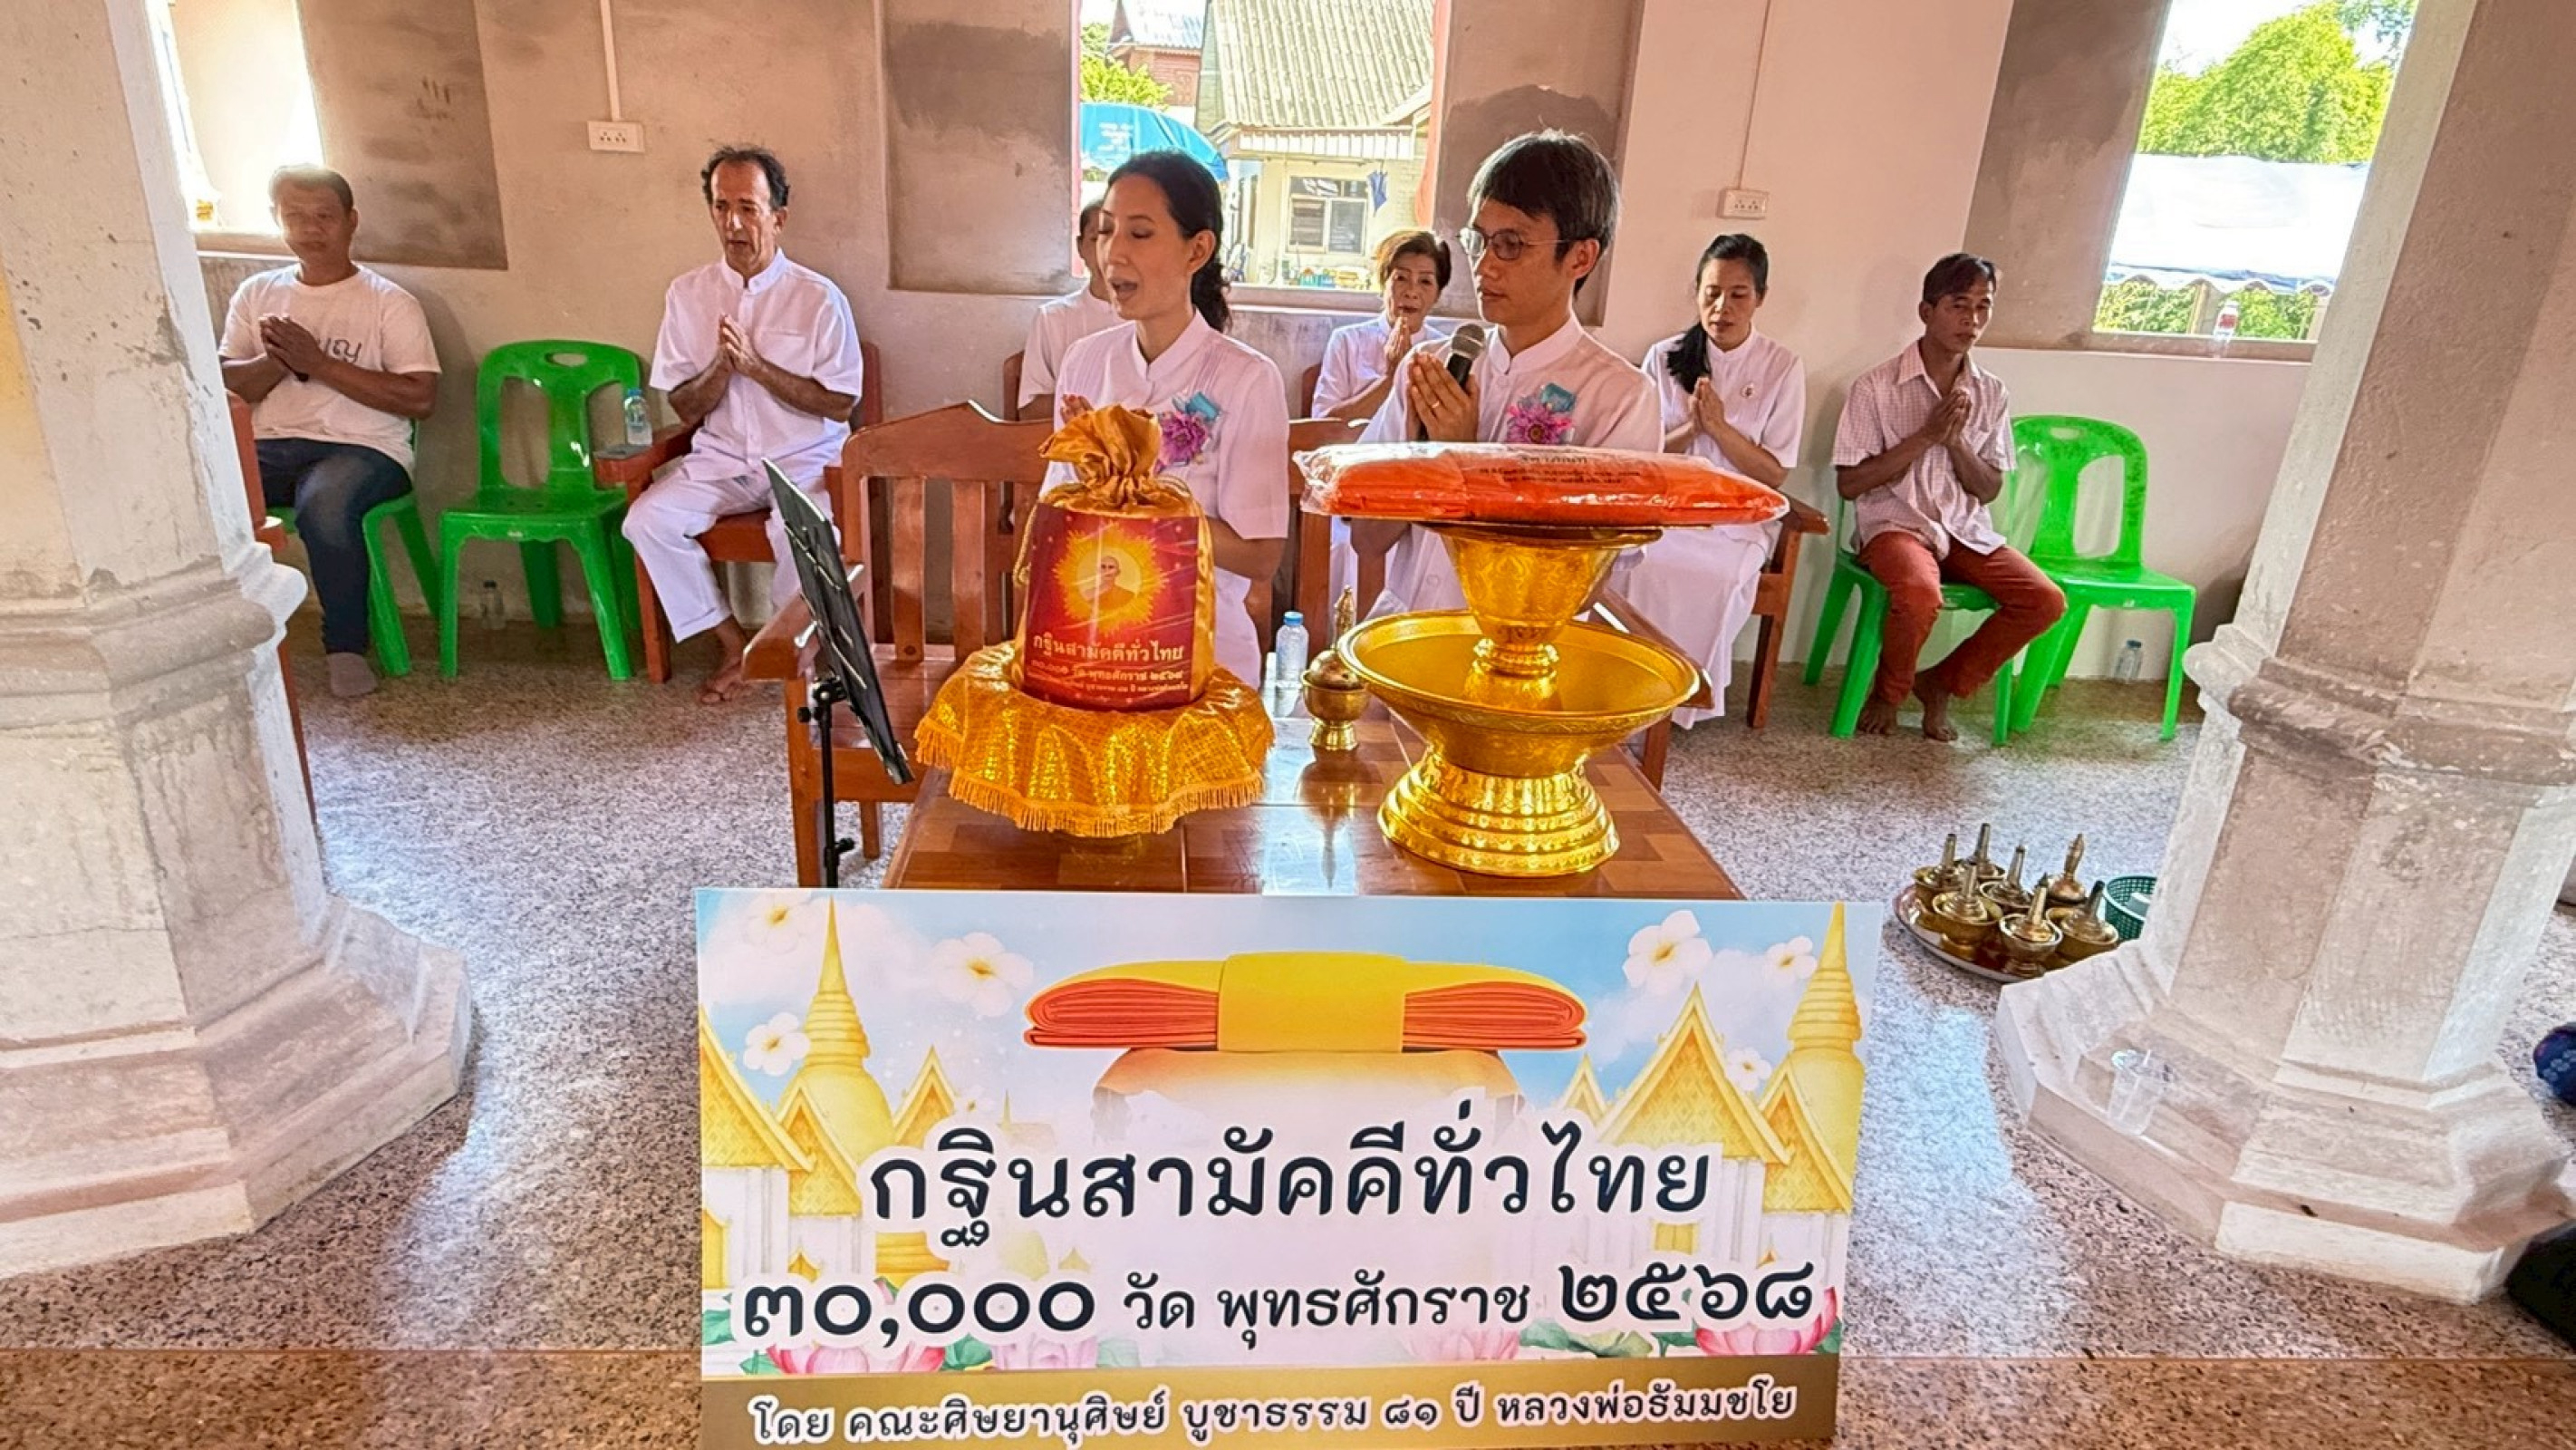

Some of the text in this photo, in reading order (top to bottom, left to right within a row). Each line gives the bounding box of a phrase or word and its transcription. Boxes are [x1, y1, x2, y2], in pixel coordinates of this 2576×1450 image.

[1033, 631, 1185, 662] กฐินสามัคคีทั่วไทย
[871, 1099, 1709, 1247] กฐินสามัคคีทั่วไทย
[745, 1262, 1814, 1349] ๓๐,๐๐๐ วัด พุทธศักราช ๒๕๖๘
[754, 1379, 1792, 1445] โดย คณะศิษยานุศิษย์ บูชาธรรม ๘๑ ปี หลวงพ่อธัมมชโย
